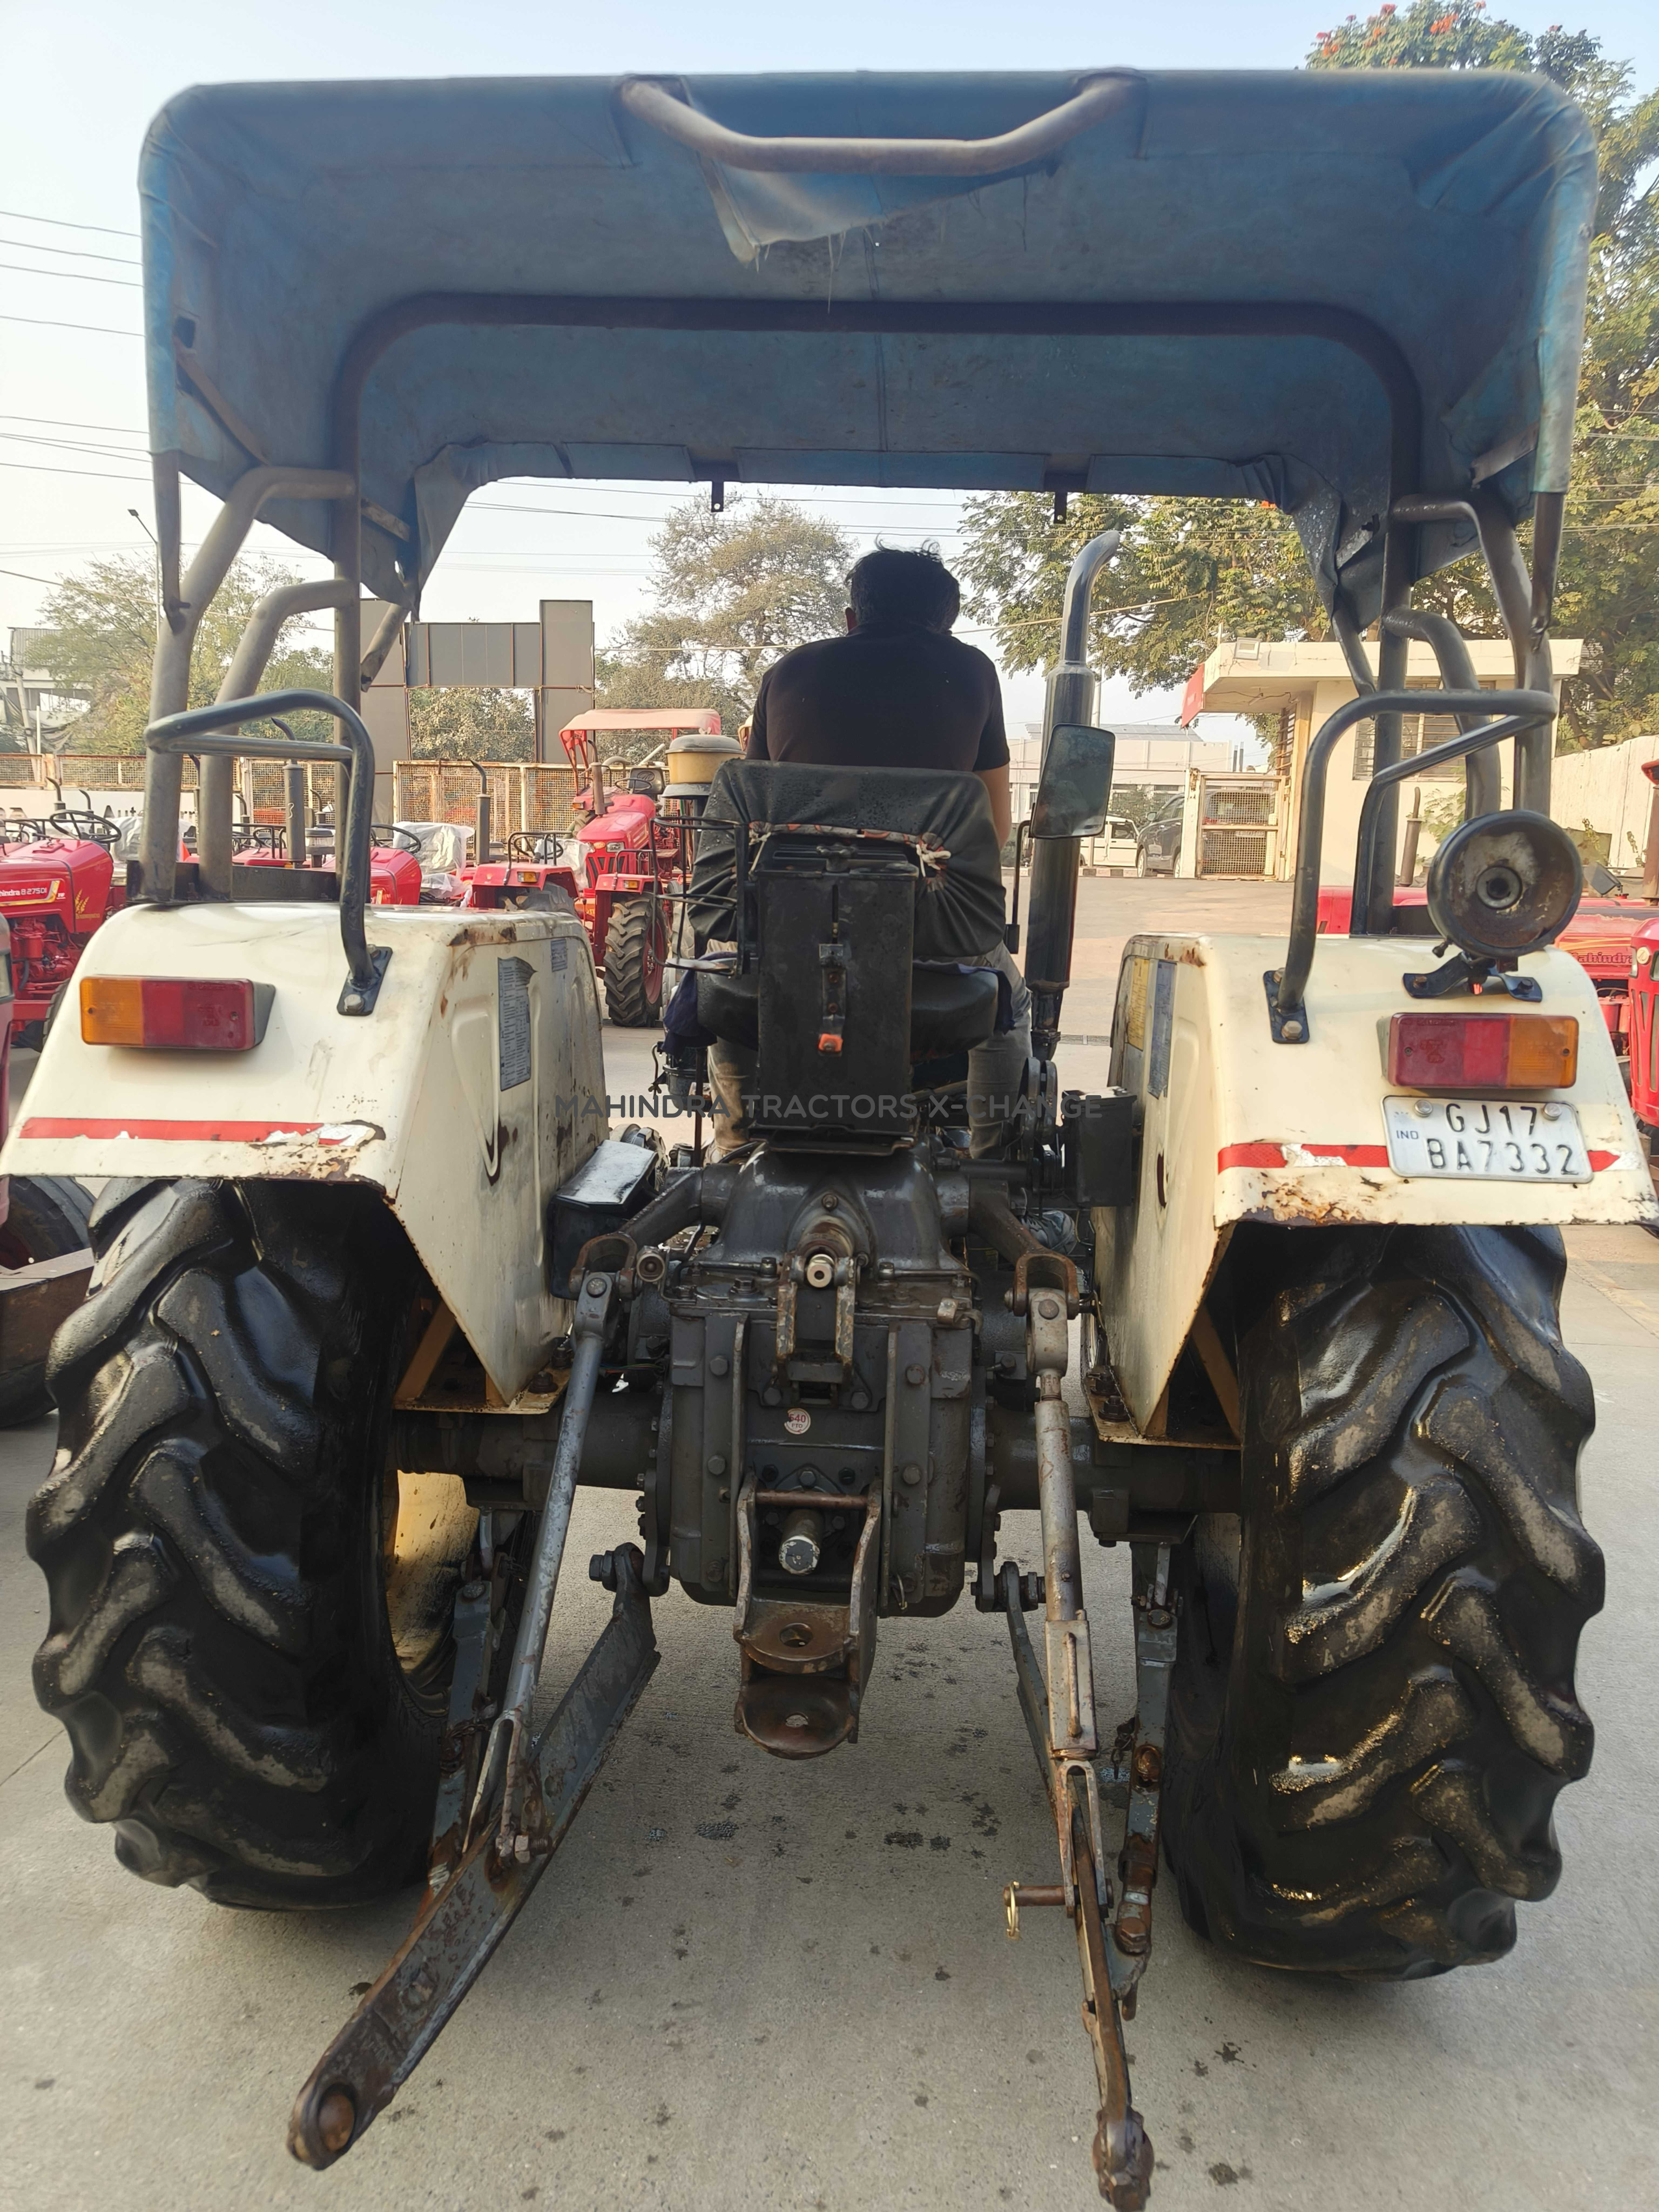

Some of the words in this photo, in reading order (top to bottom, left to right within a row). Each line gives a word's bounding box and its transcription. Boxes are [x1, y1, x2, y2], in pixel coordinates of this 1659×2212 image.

[1446, 1103, 1537, 1135] GJ17
[1396, 1130, 1419, 1140] IND
[1427, 1138, 1579, 1176] BA7332
[790, 1414, 806, 1422] 540
